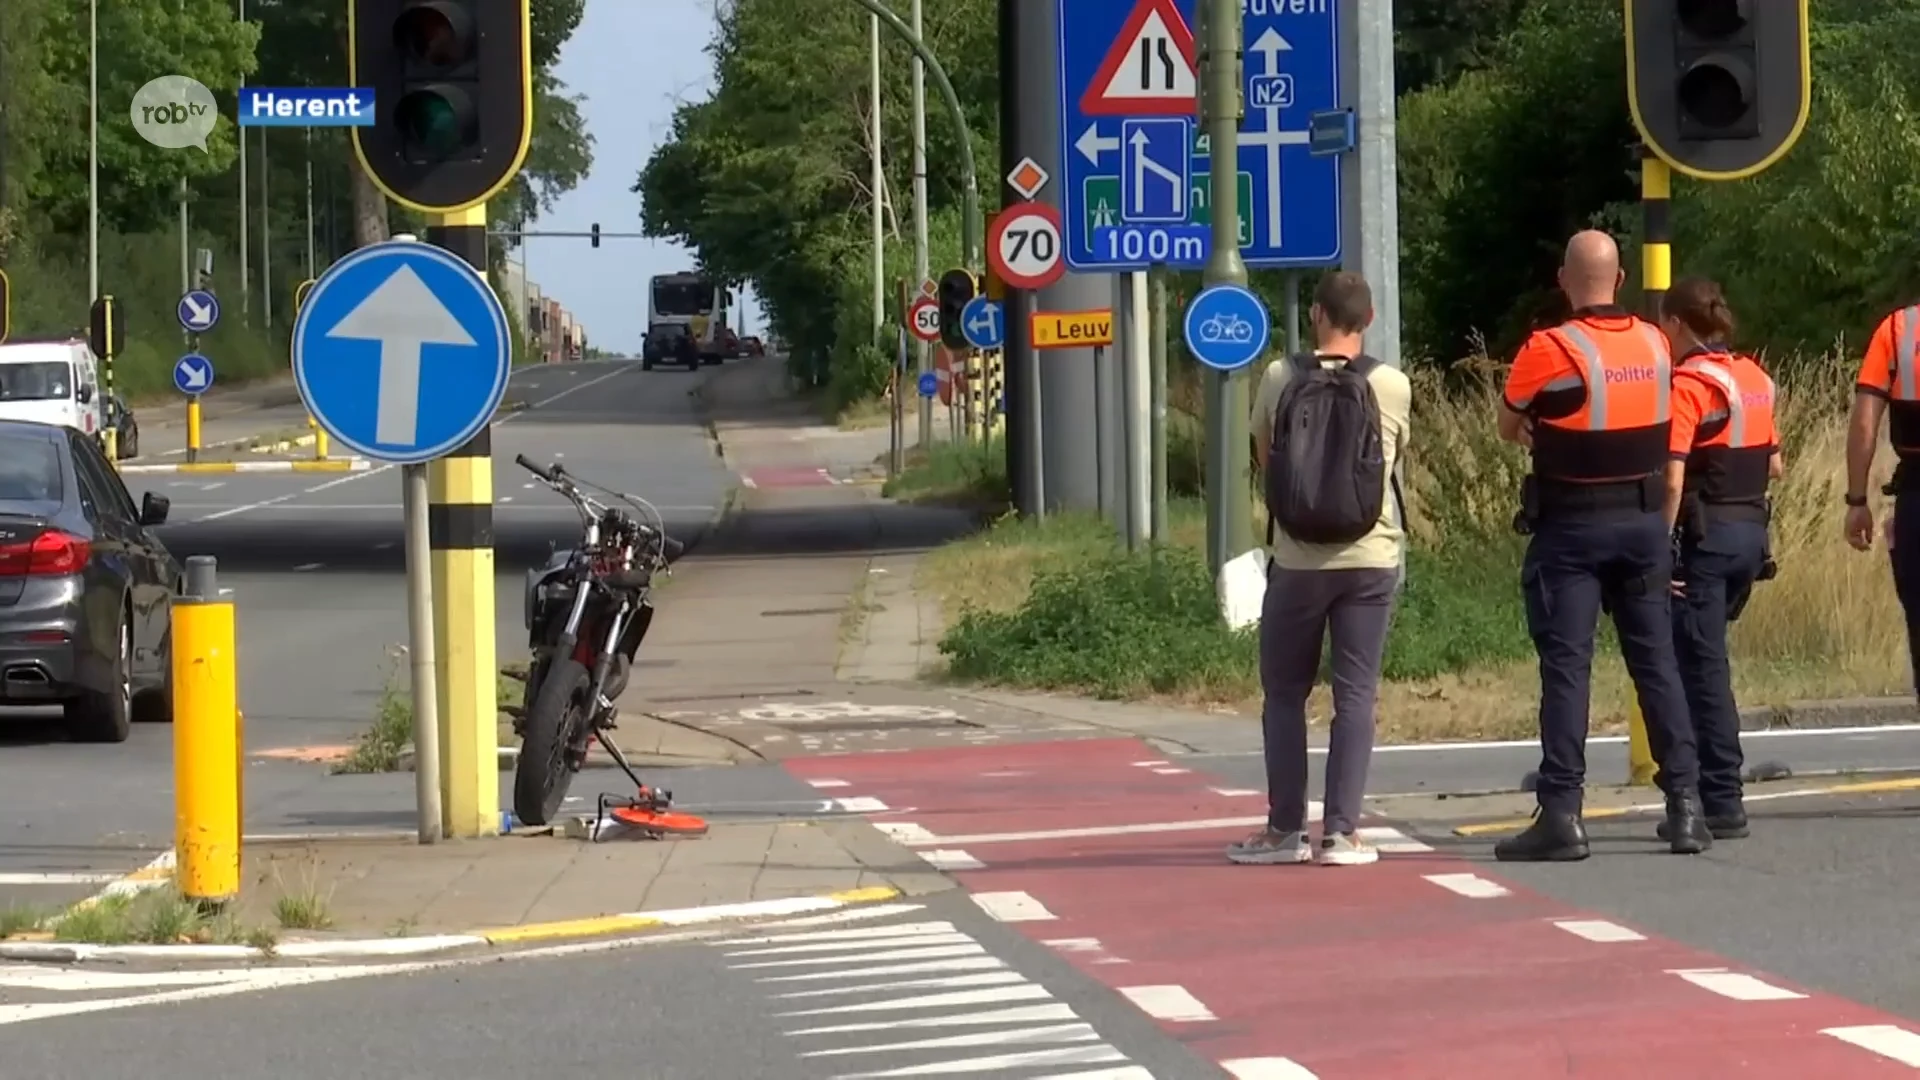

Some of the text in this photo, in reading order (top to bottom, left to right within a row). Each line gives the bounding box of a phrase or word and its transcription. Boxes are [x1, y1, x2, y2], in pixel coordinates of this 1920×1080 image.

[1240, 0, 1327, 16] uven
[1256, 79, 1288, 104] N2
[1006, 229, 1054, 263] 70
[1108, 229, 1203, 261] 100m
[917, 310, 941, 329] 50
[1604, 364, 1655, 385] Politie
